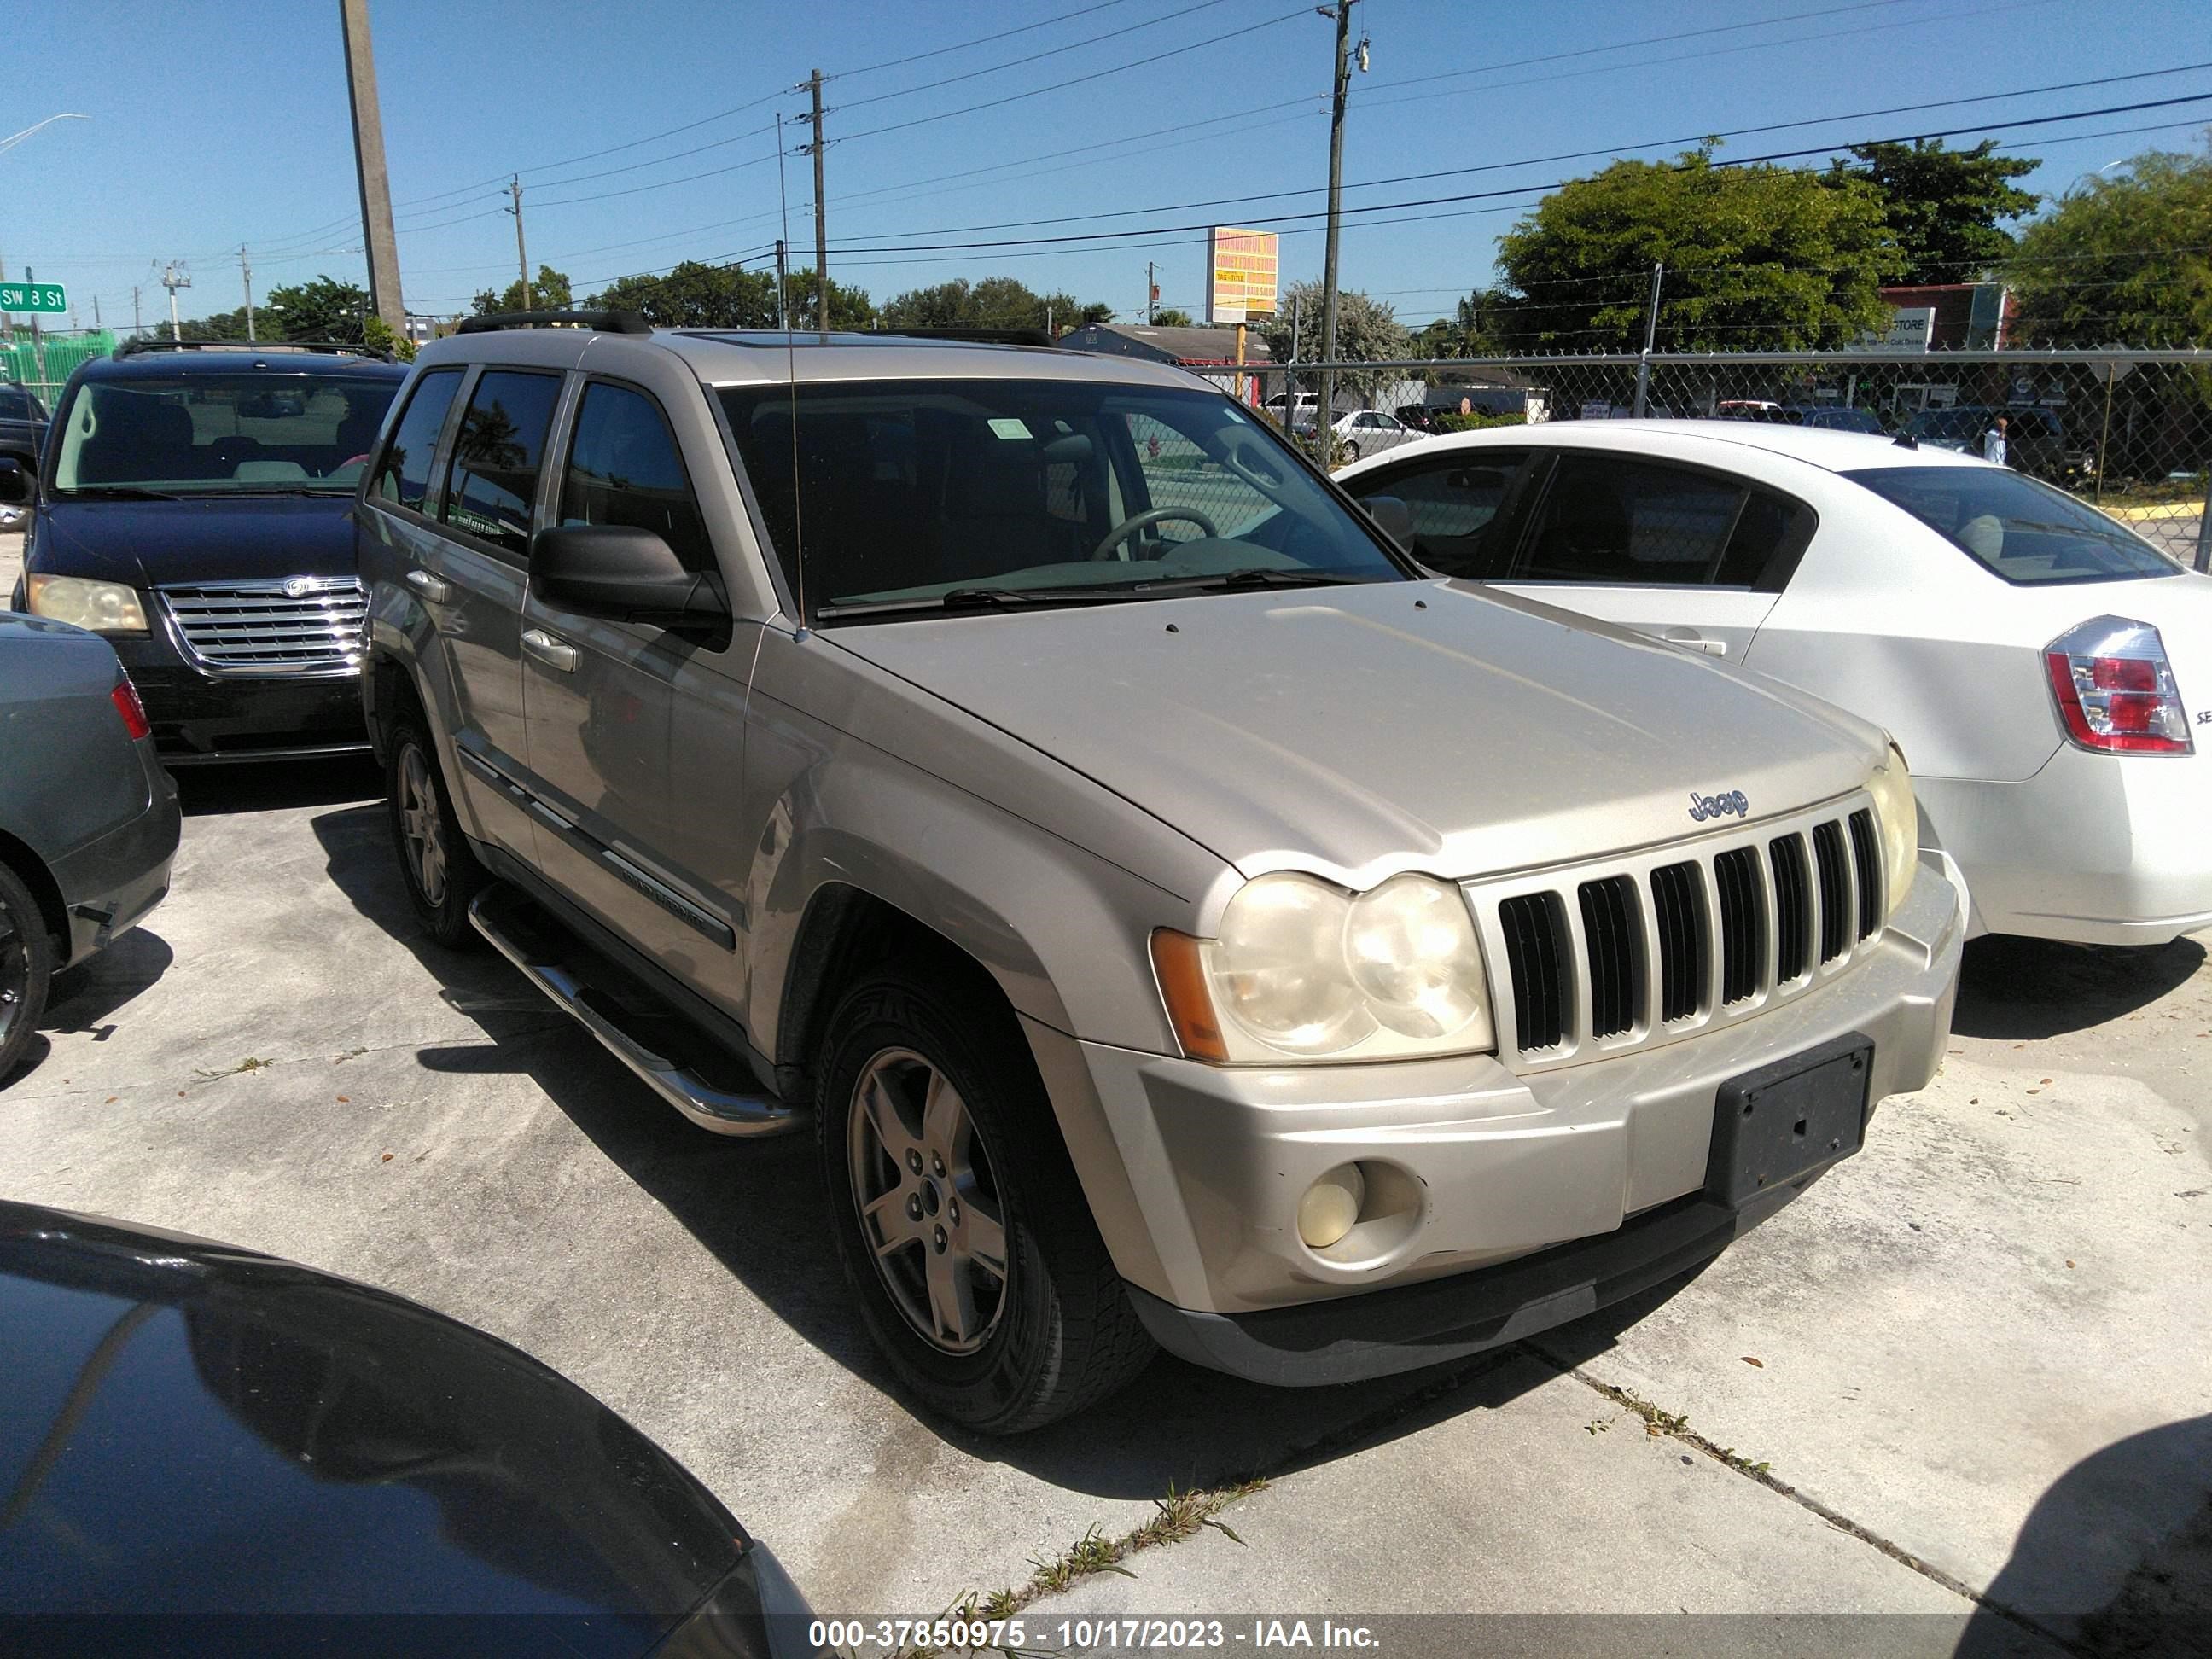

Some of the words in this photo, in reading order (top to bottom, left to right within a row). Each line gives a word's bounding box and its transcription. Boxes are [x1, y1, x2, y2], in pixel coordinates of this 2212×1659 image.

[2, 290, 23, 305] SW
[46, 291, 63, 306] St
[1688, 789, 1749, 822] Jeep
